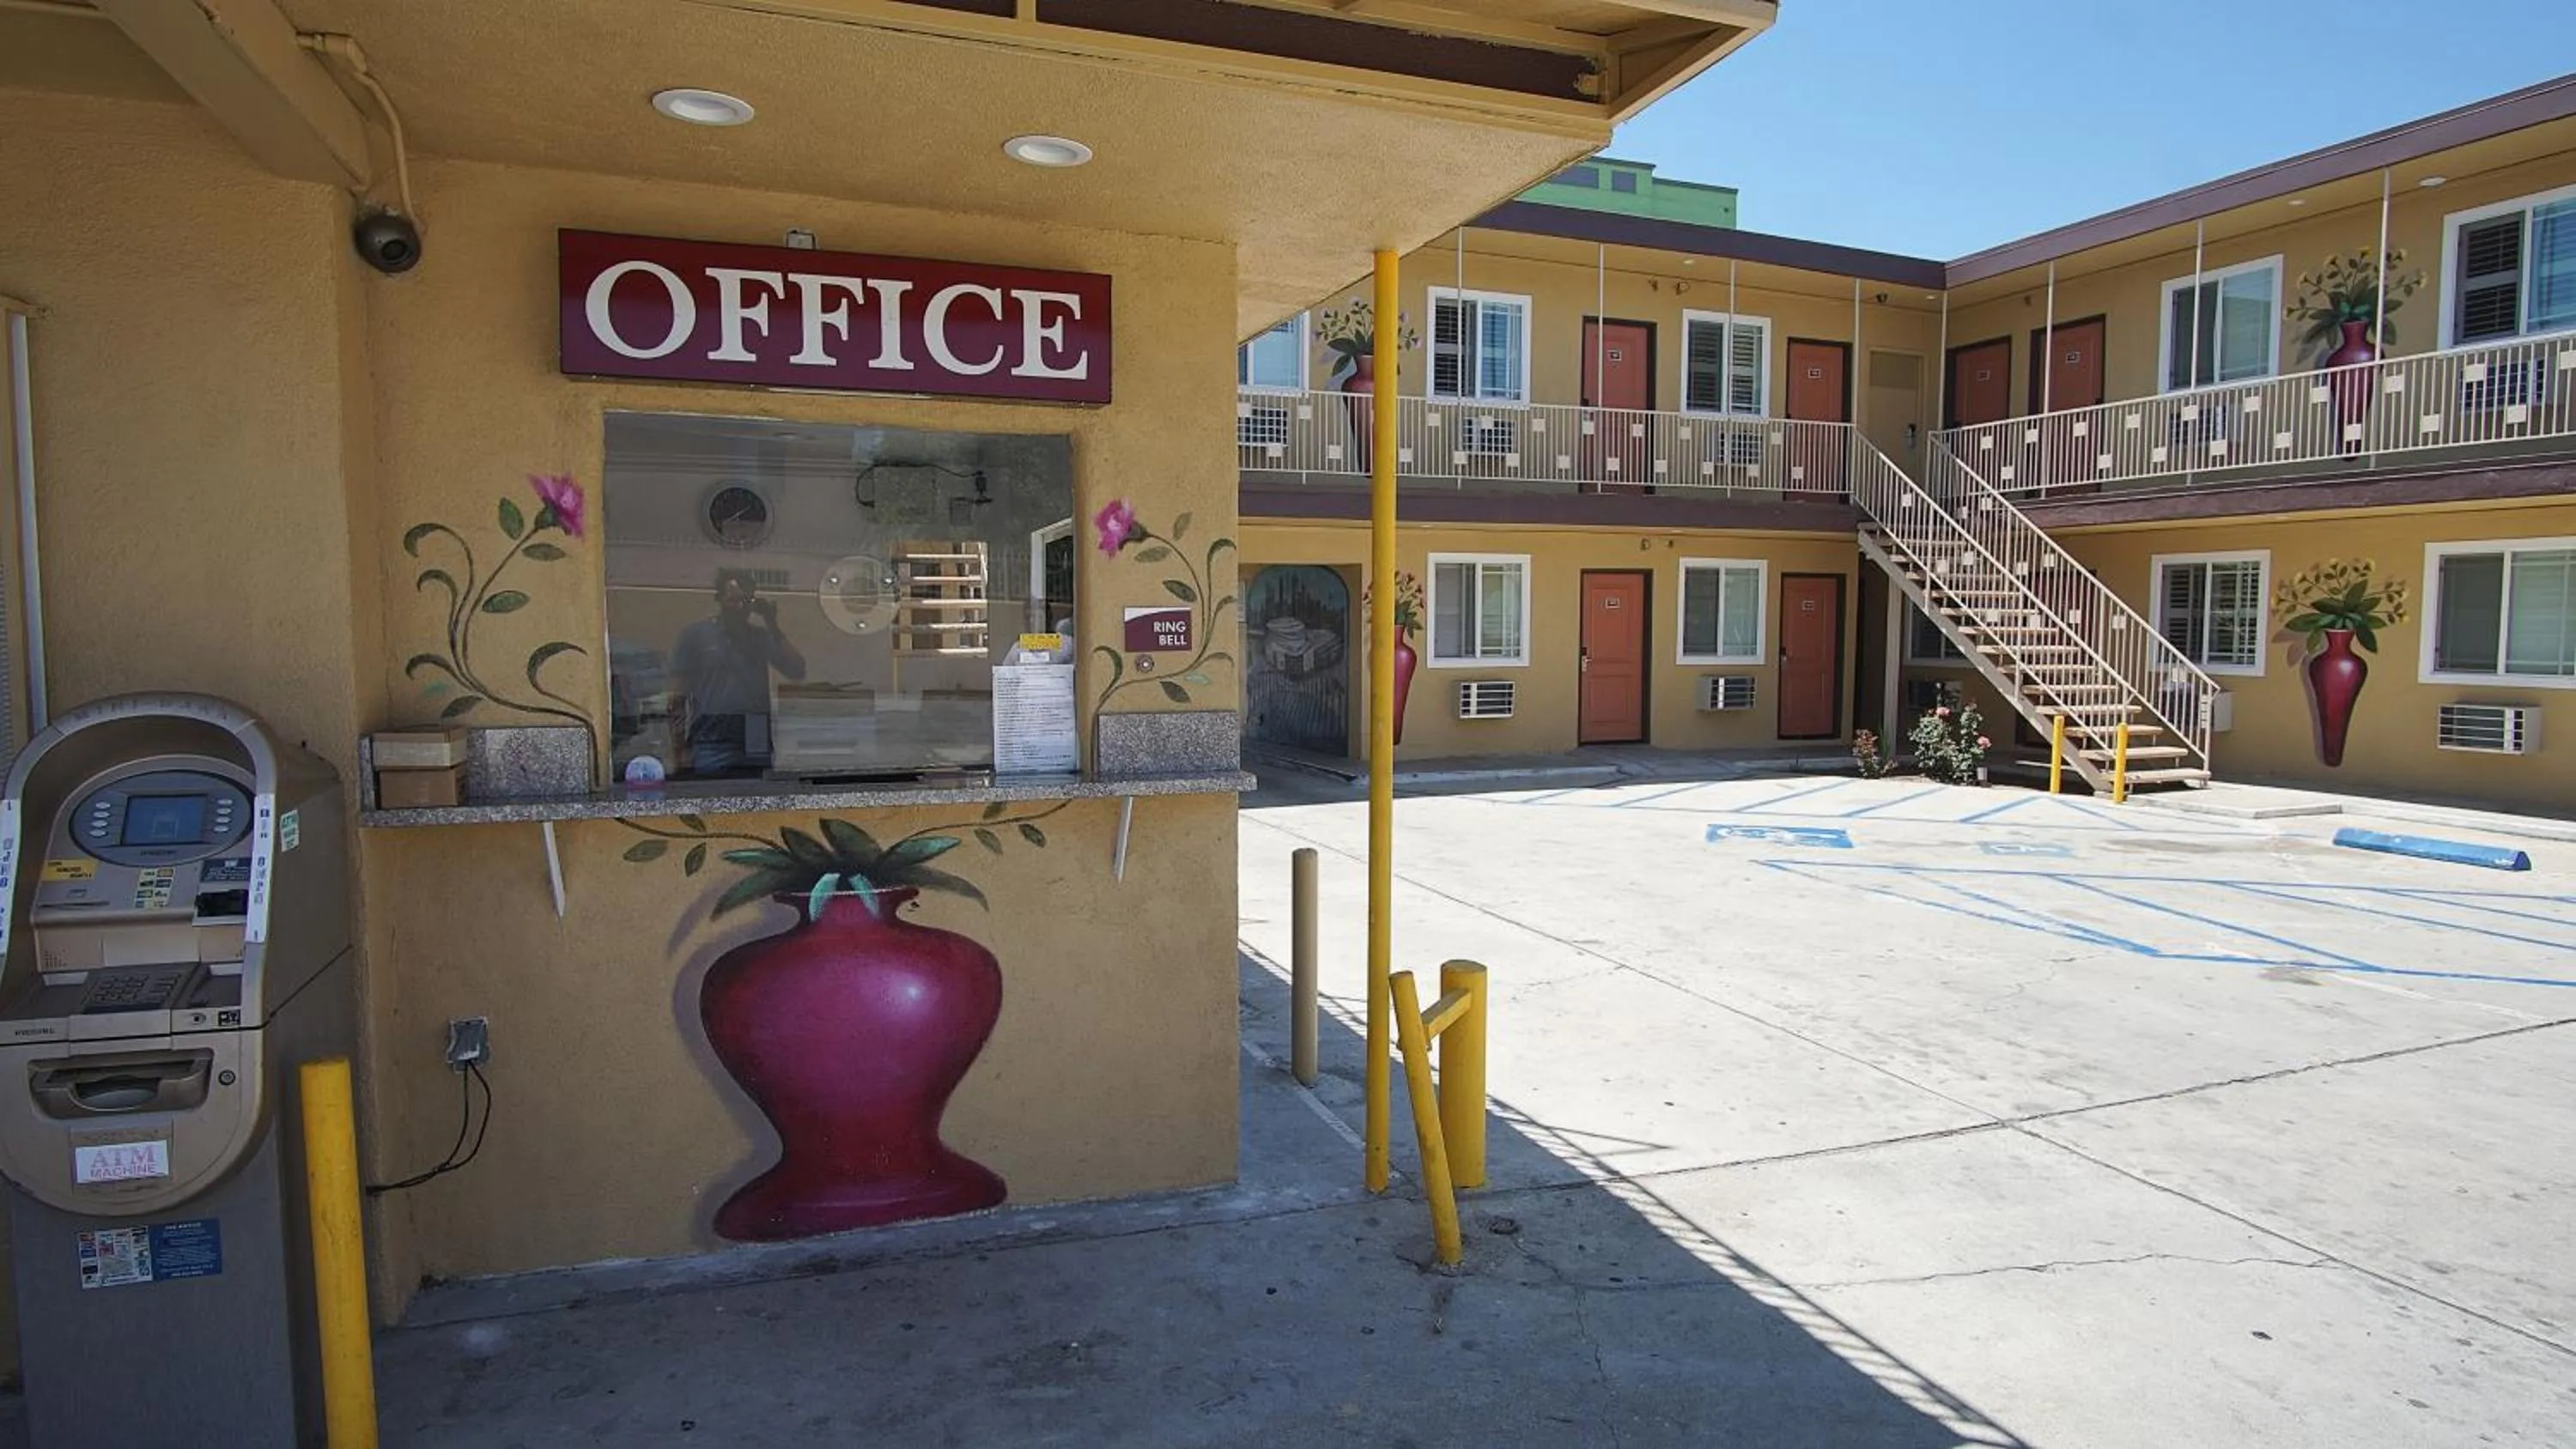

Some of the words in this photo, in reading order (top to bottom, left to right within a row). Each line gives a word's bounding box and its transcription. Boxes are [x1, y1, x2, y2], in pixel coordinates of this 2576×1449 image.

[584, 259, 1089, 380] OFFICE
[1153, 621, 1187, 633] RING
[1158, 634, 1188, 646] BELL
[91, 1144, 156, 1168] ATM
[90, 1163, 156, 1179] MACHINE
